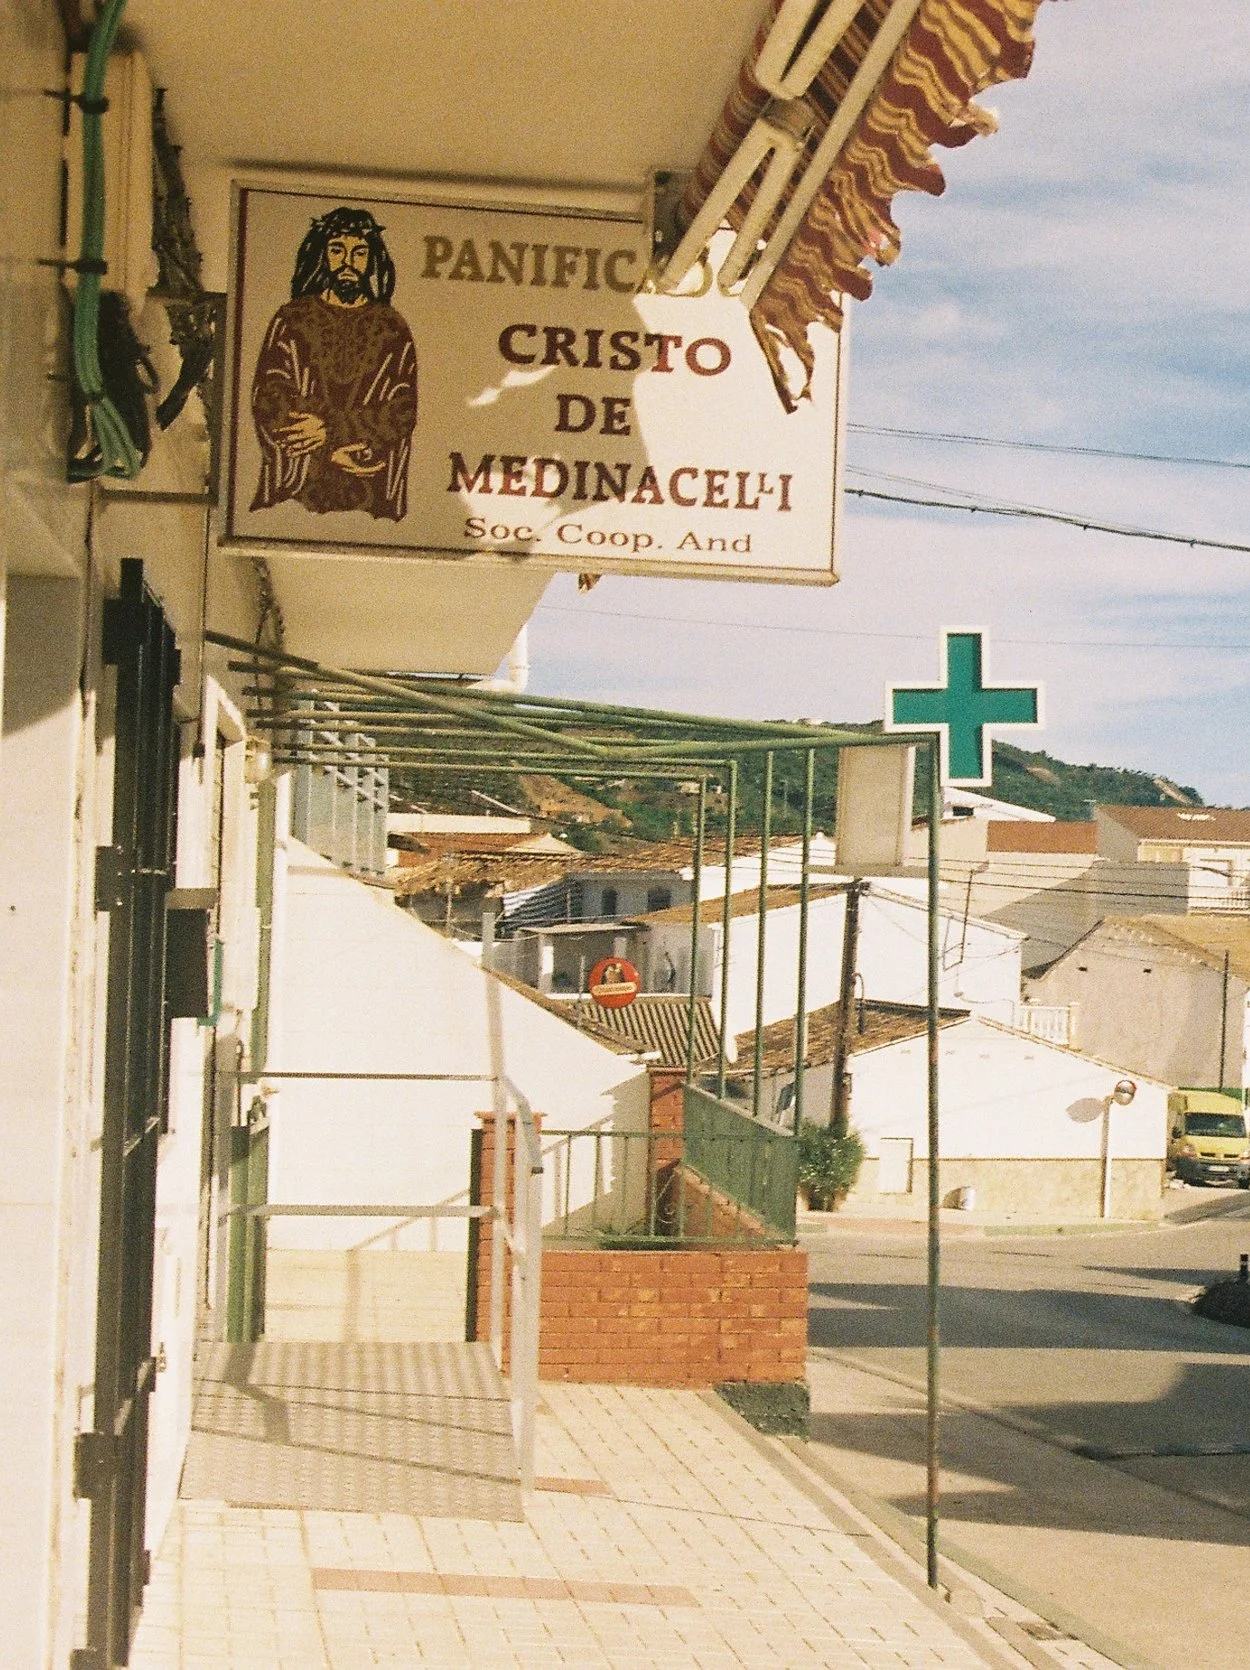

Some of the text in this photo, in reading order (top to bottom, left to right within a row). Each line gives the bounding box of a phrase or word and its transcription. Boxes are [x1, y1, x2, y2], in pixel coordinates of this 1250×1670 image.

[498, 323, 732, 376] CRISTO
[554, 393, 631, 436] DE
[463, 517, 752, 554] Soc. Coop. And
